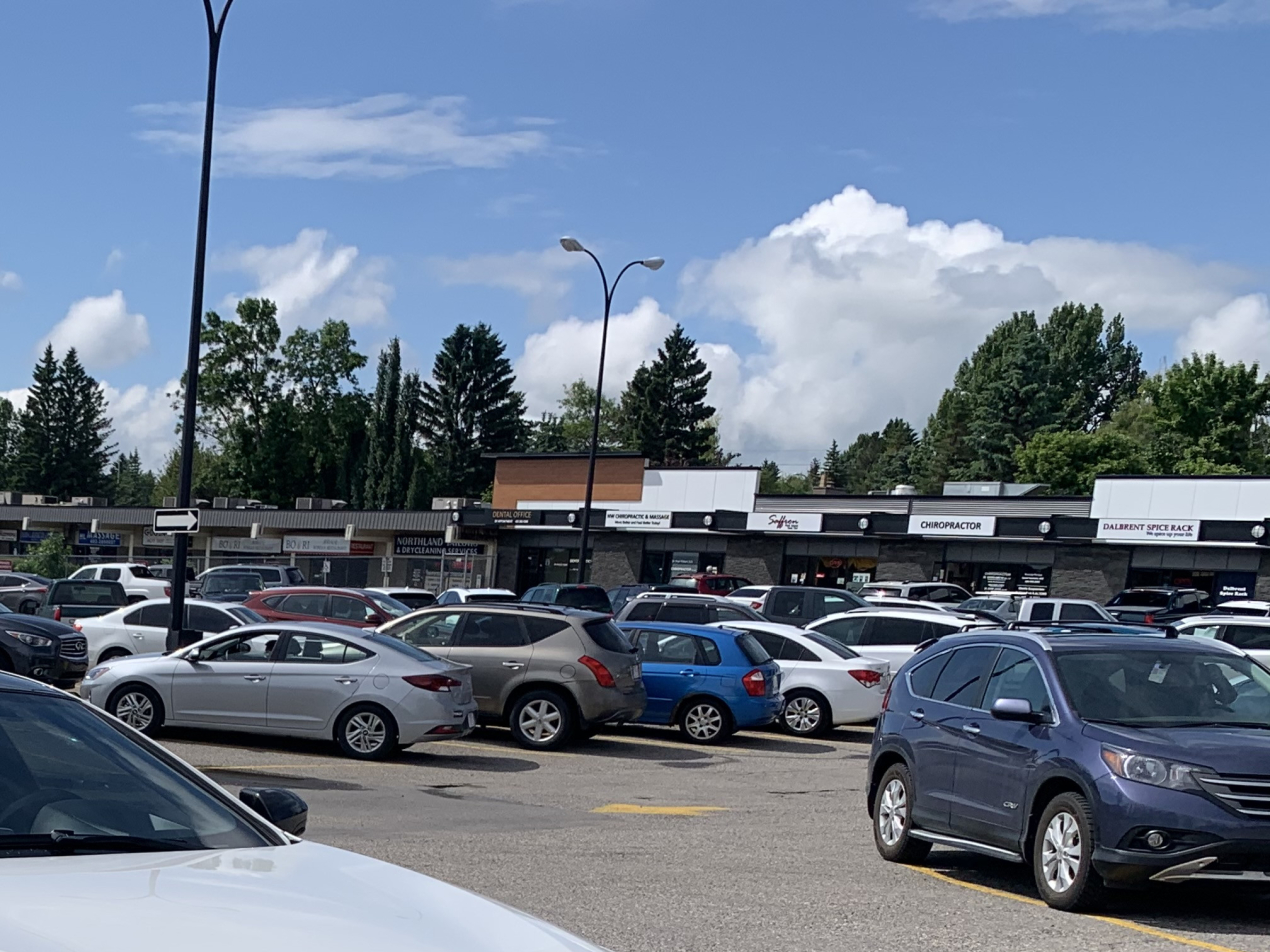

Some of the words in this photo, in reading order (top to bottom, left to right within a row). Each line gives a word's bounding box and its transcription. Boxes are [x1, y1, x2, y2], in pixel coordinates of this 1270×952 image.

[492, 511, 512, 519] DENTAL
[513, 511, 532, 519] OFFICE
[768, 514, 799, 529] Saffron
[920, 521, 982, 530] CHIROPRACTOR
[1103, 523, 1145, 531] DALBRENT
[1146, 524, 1169, 532] SPICE
[1170, 524, 1194, 532] RACK
[87, 532, 121, 540] MASSAGE
[396, 537, 444, 546] NORTHLAND
